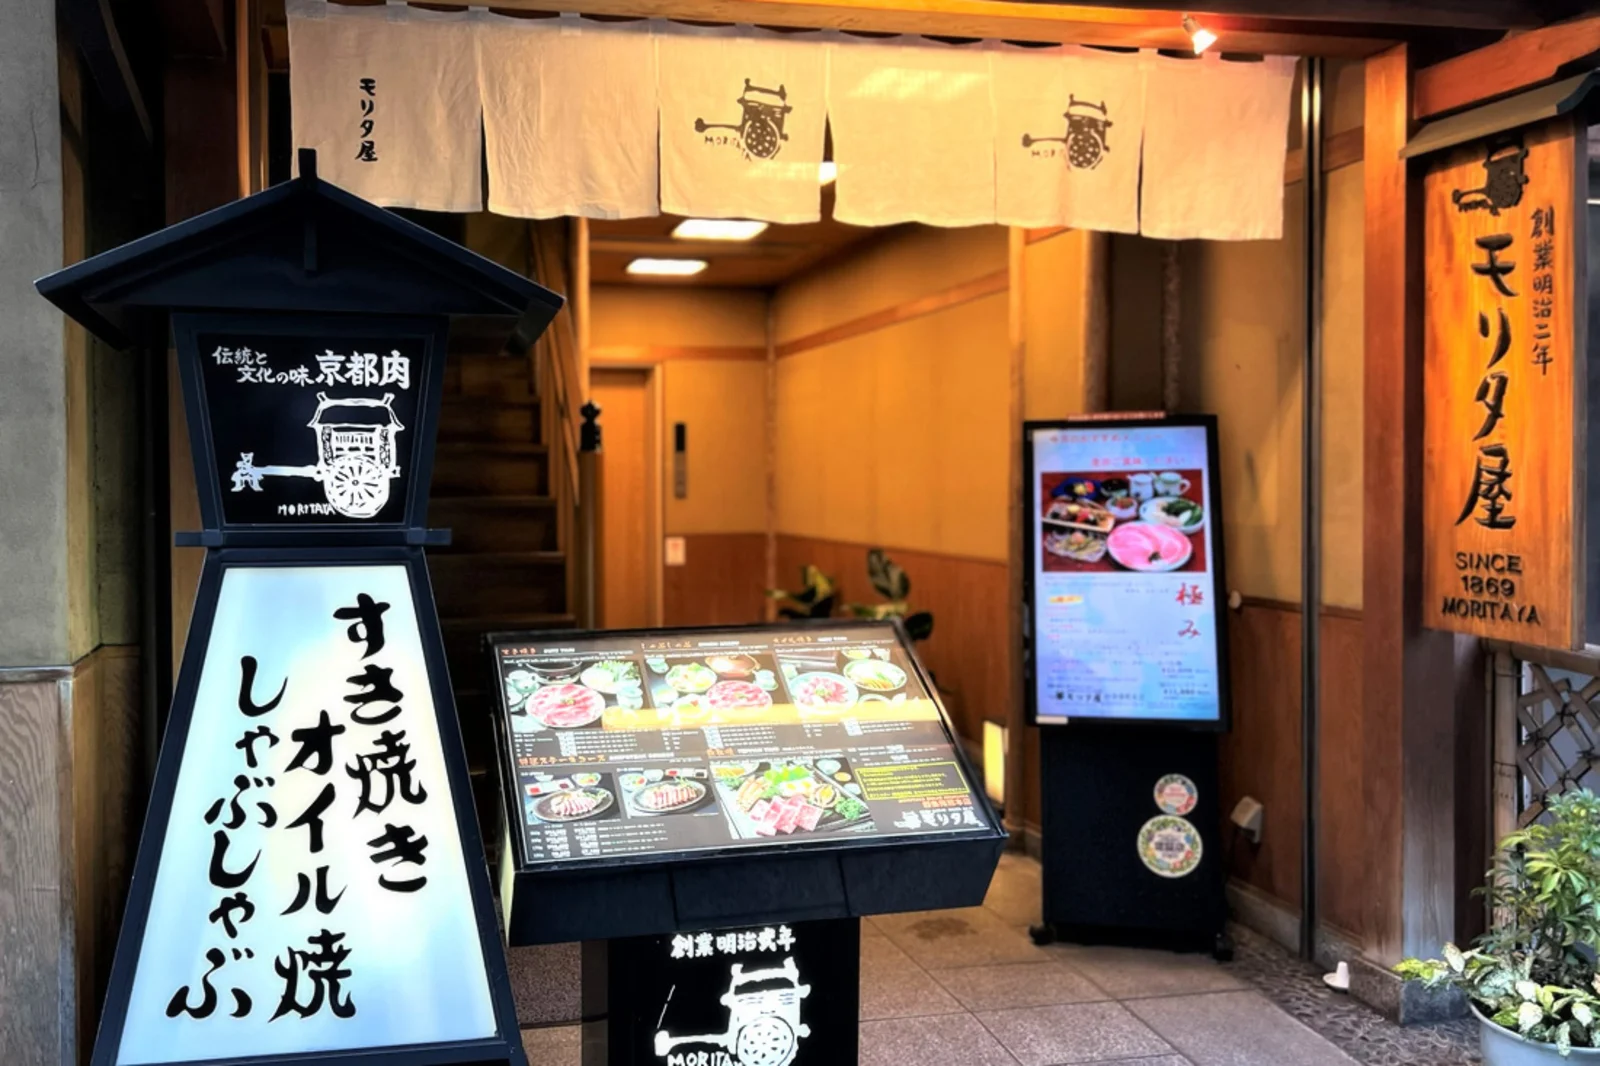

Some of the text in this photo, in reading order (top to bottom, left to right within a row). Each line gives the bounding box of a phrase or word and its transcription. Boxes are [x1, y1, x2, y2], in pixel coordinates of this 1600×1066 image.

[355, 78, 378, 162] モリタ屋
[1530, 205, 1555, 376] 創業明治二年
[211, 345, 267, 365] 伝統と
[236, 365, 314, 387] 文化の味
[315, 350, 411, 389] 京都肉
[1455, 233, 1519, 531] モリタ屋
[1456, 551, 1522, 576] SINCE
[1461, 575, 1515, 598] 1869
[1442, 596, 1541, 626] MORITAYA
[332, 592, 429, 893] すき焼き
[165, 655, 289, 1020] しゃぶしゃぶ
[267, 709, 357, 1024] オイル焼
